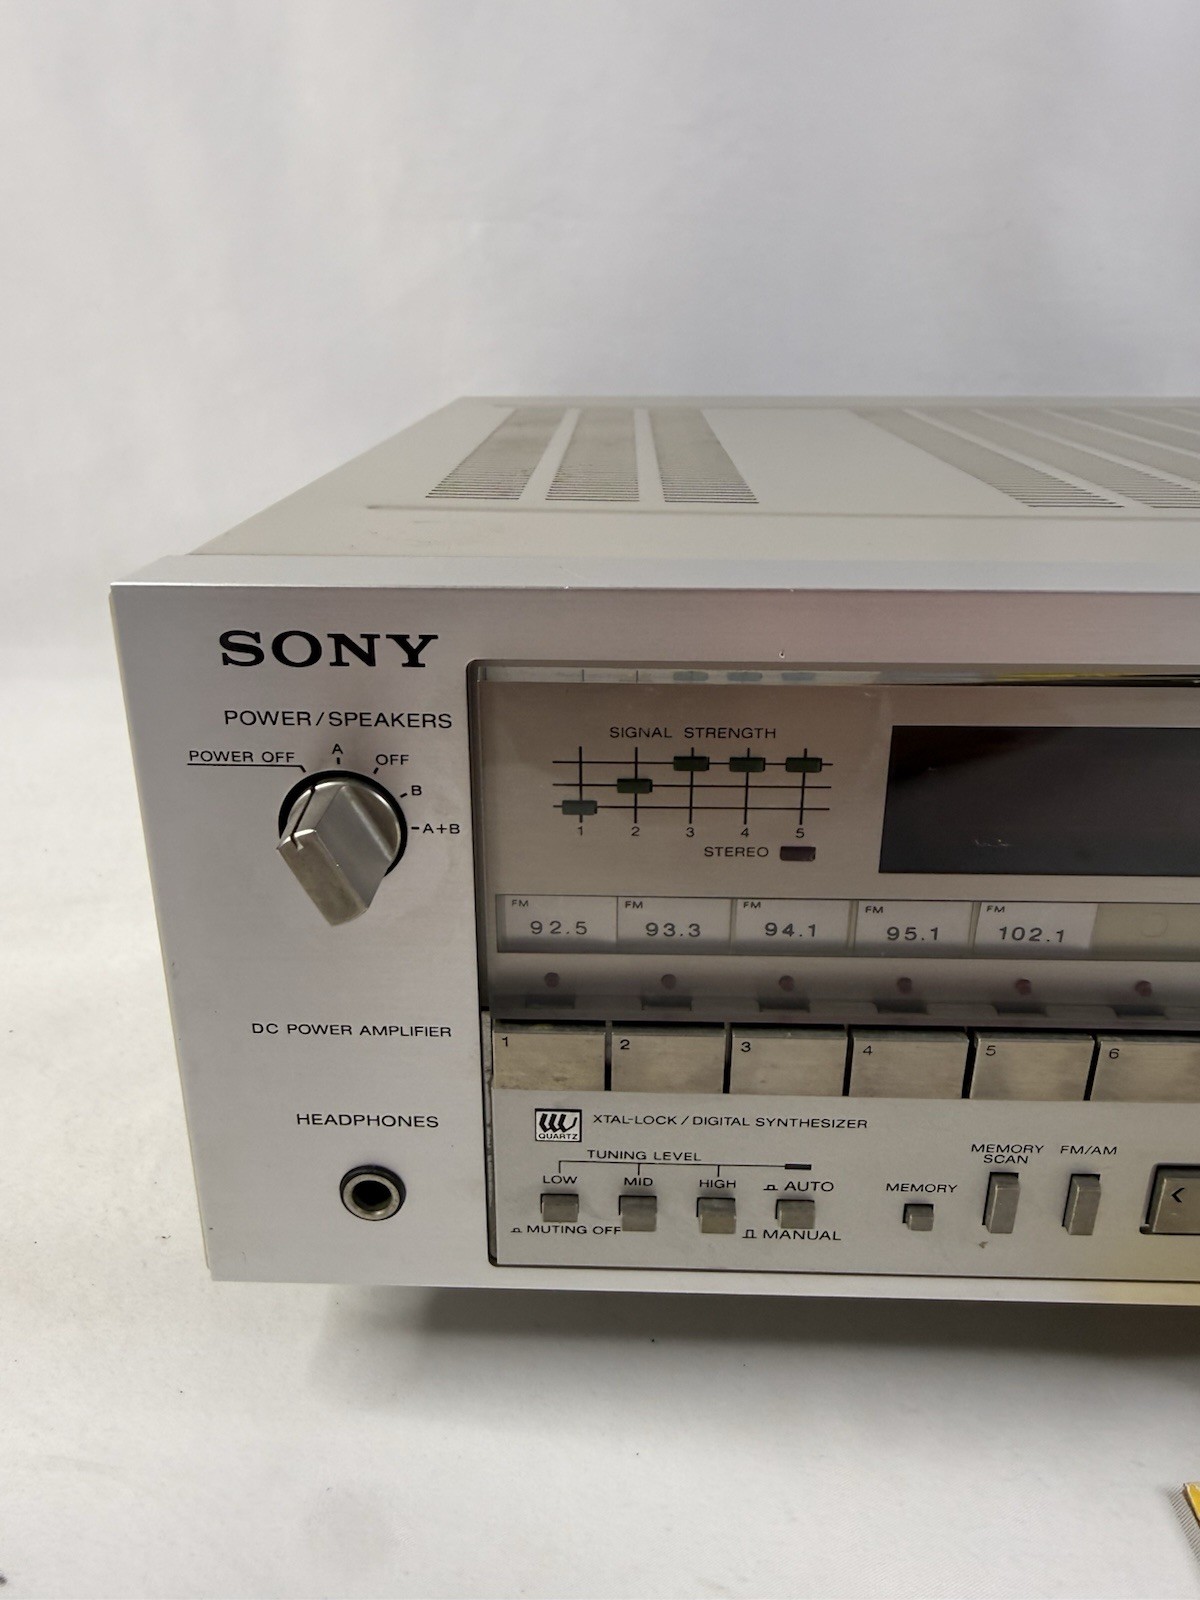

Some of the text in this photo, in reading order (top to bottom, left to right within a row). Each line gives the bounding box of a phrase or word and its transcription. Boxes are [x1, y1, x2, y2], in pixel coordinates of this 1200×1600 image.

[219, 630, 438, 667] SONY
[609, 727, 776, 739] SIGNAL STRENGTH
[332, 743, 343, 754] A
[189, 750, 295, 763] POWER OFF
[375, 754, 409, 765] OFF
[411, 785, 422, 796] B
[422, 823, 460, 835] A+B
[577, 826, 805, 838] 1 2 3 4 5
[703, 846, 769, 857] STEREO
[511, 899, 529, 908] FM
[624, 900, 644, 909] FM
[743, 901, 762, 909] FM
[986, 905, 1006, 913] FM
[865, 905, 884, 914] FM
[530, 920, 588, 935] 92.5
[645, 922, 701, 937] 93.3
[764, 922, 816, 937] 94.1
[886, 927, 939, 941] 95.1
[999, 926, 1065, 943] 102.1
[252, 1023, 452, 1037] DC POWER AMPLIFIER
[502, 1036, 509, 1047] 1
[620, 1039, 630, 1050] 2
[741, 1041, 751, 1052] 3
[862, 1045, 873, 1056] 4
[985, 1045, 997, 1056] 5
[1108, 1047, 1120, 1059] 6
[296, 1113, 439, 1128] HEADPHONES
[755, 1117, 868, 1129] SYNTHESIZER
[538, 1132, 578, 1141] QUARTZ
[970, 1143, 1045, 1154] MEMORY
[1060, 1145, 1118, 1155] FM/AM
[587, 1149, 702, 1162] TUNING LEVEL
[983, 1154, 1029, 1164] SCAN
[542, 1175, 578, 1185] LOW
[624, 1177, 654, 1187] MID
[699, 1178, 737, 1189] HIGH
[785, 1181, 835, 1193] AUTO
[885, 1183, 958, 1193] MEMORY
[526, 1224, 622, 1236] MUTING OFF
[762, 1229, 842, 1242] MANUAL
